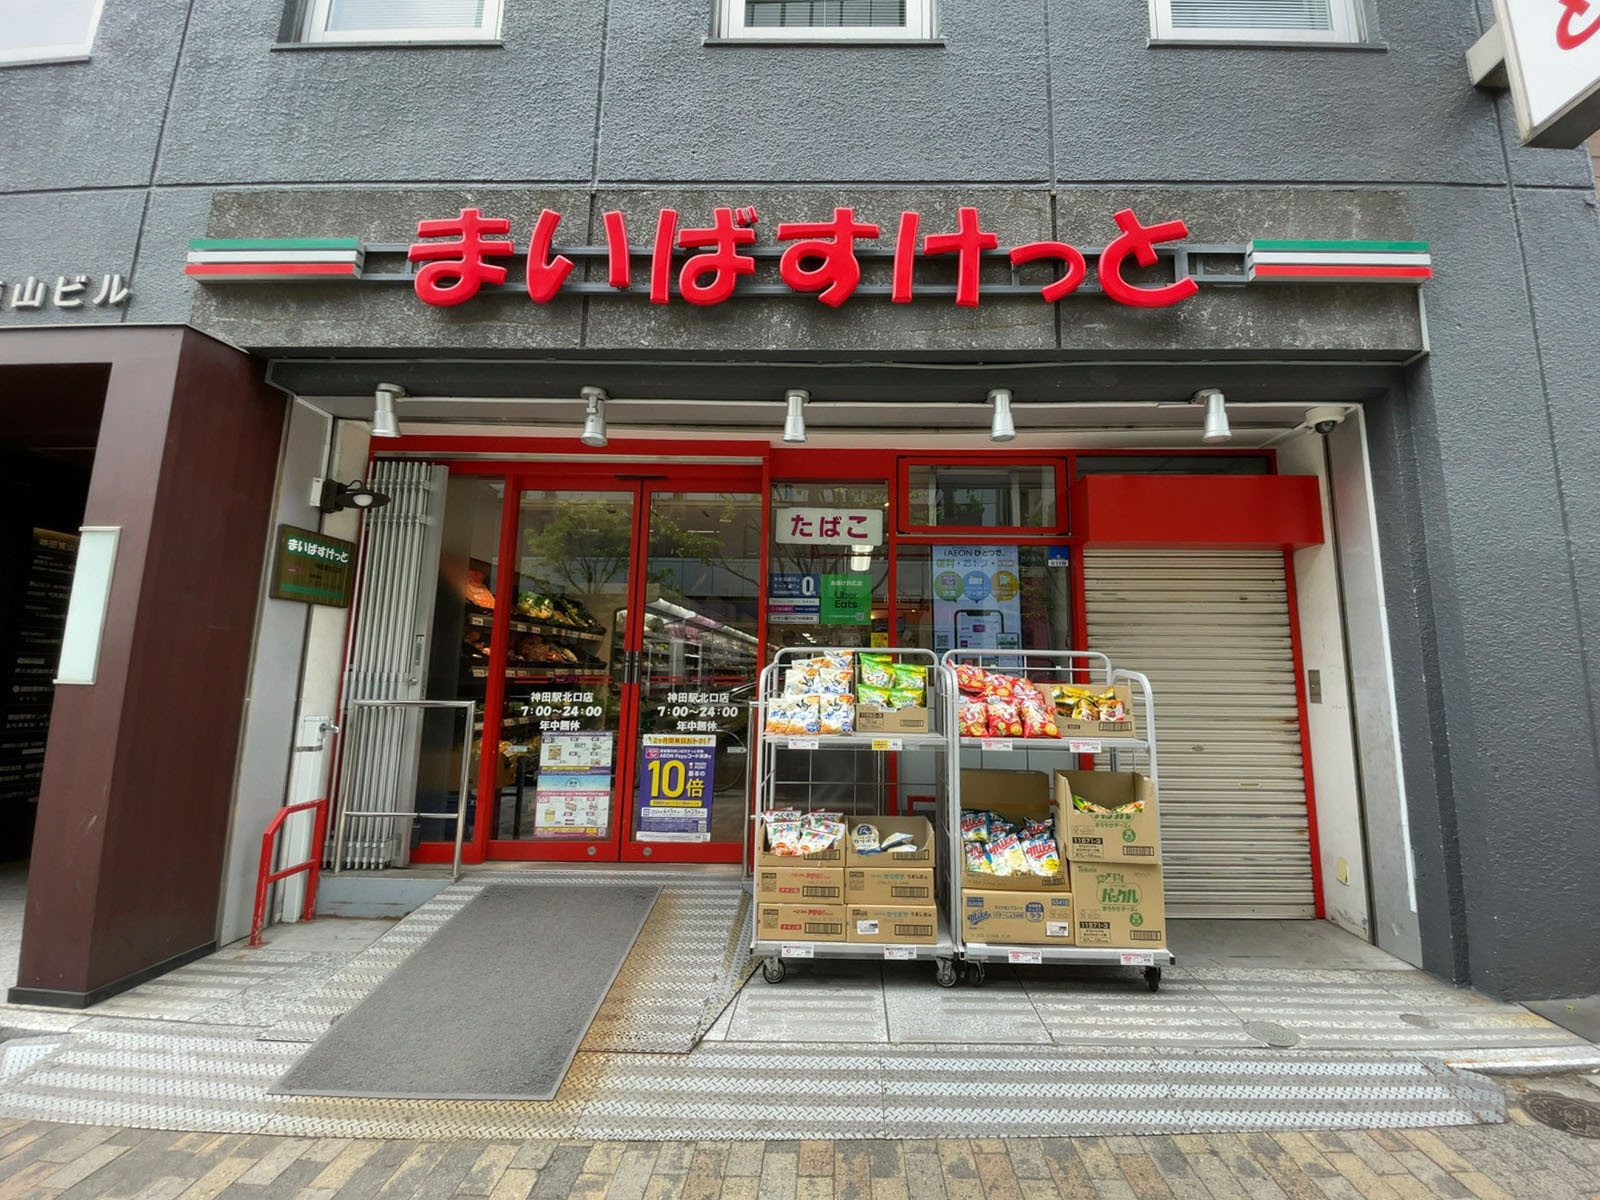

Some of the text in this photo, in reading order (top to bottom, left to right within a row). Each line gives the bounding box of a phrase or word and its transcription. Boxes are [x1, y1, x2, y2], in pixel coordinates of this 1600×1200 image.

[408, 205, 1198, 308] まいばすけっと
[0, 273, 129, 308] 山ビル
[790, 514, 869, 539] たばこ
[287, 538, 349, 563] まいばすけっと
[834, 591, 858, 600] Uber
[834, 600, 858, 608] Eats
[530, 691, 594, 703] 神田駅北口店
[667, 692, 729, 703] 神田駅北口店
[539, 720, 581, 731] 年中無休
[676, 720, 718, 731] 年中無休
[989, 835, 1019, 855] Mike
[1025, 842, 1057, 859] Mike
[967, 910, 991, 925] Mike
